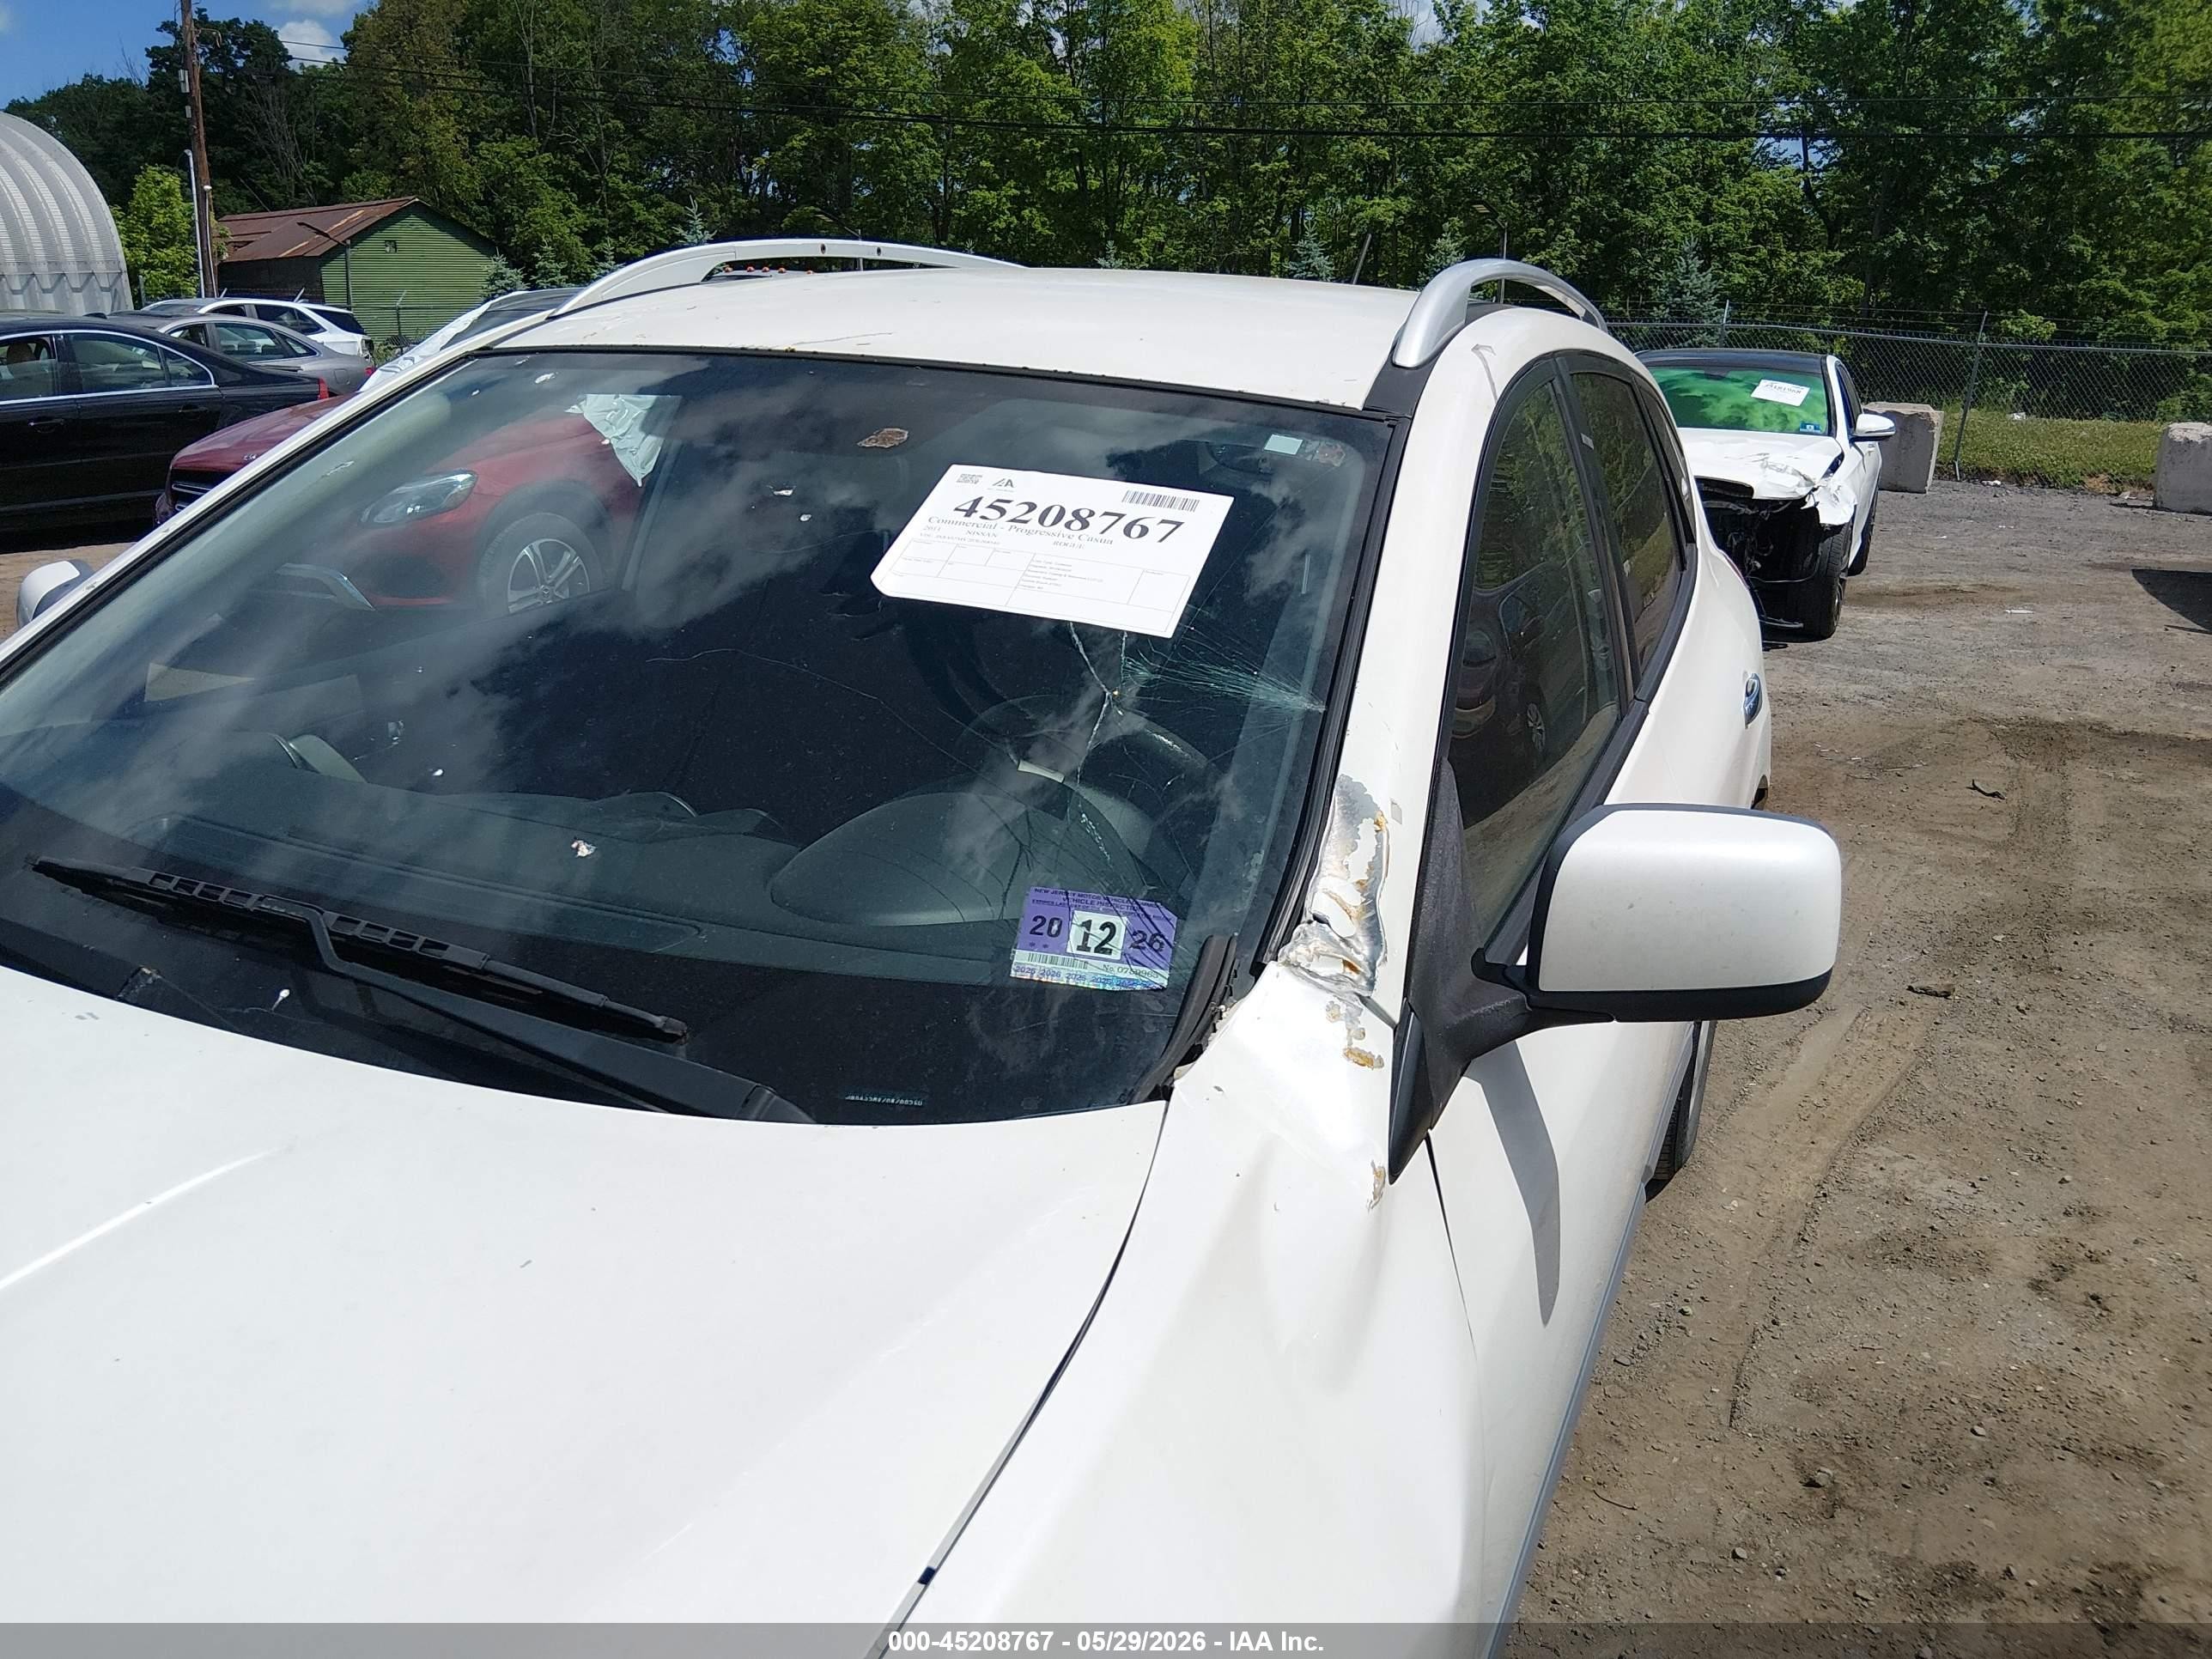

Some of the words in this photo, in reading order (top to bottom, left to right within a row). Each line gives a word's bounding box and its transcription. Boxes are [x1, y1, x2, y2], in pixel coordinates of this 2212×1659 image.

[927, 516, 998, 530] Commercial
[1008, 525, 1075, 538] Progressive
[953, 495, 1185, 544] 45208767
[1030, 915, 1062, 938] 20
[1076, 919, 1116, 956] 12
[1129, 930, 1164, 952] 26
